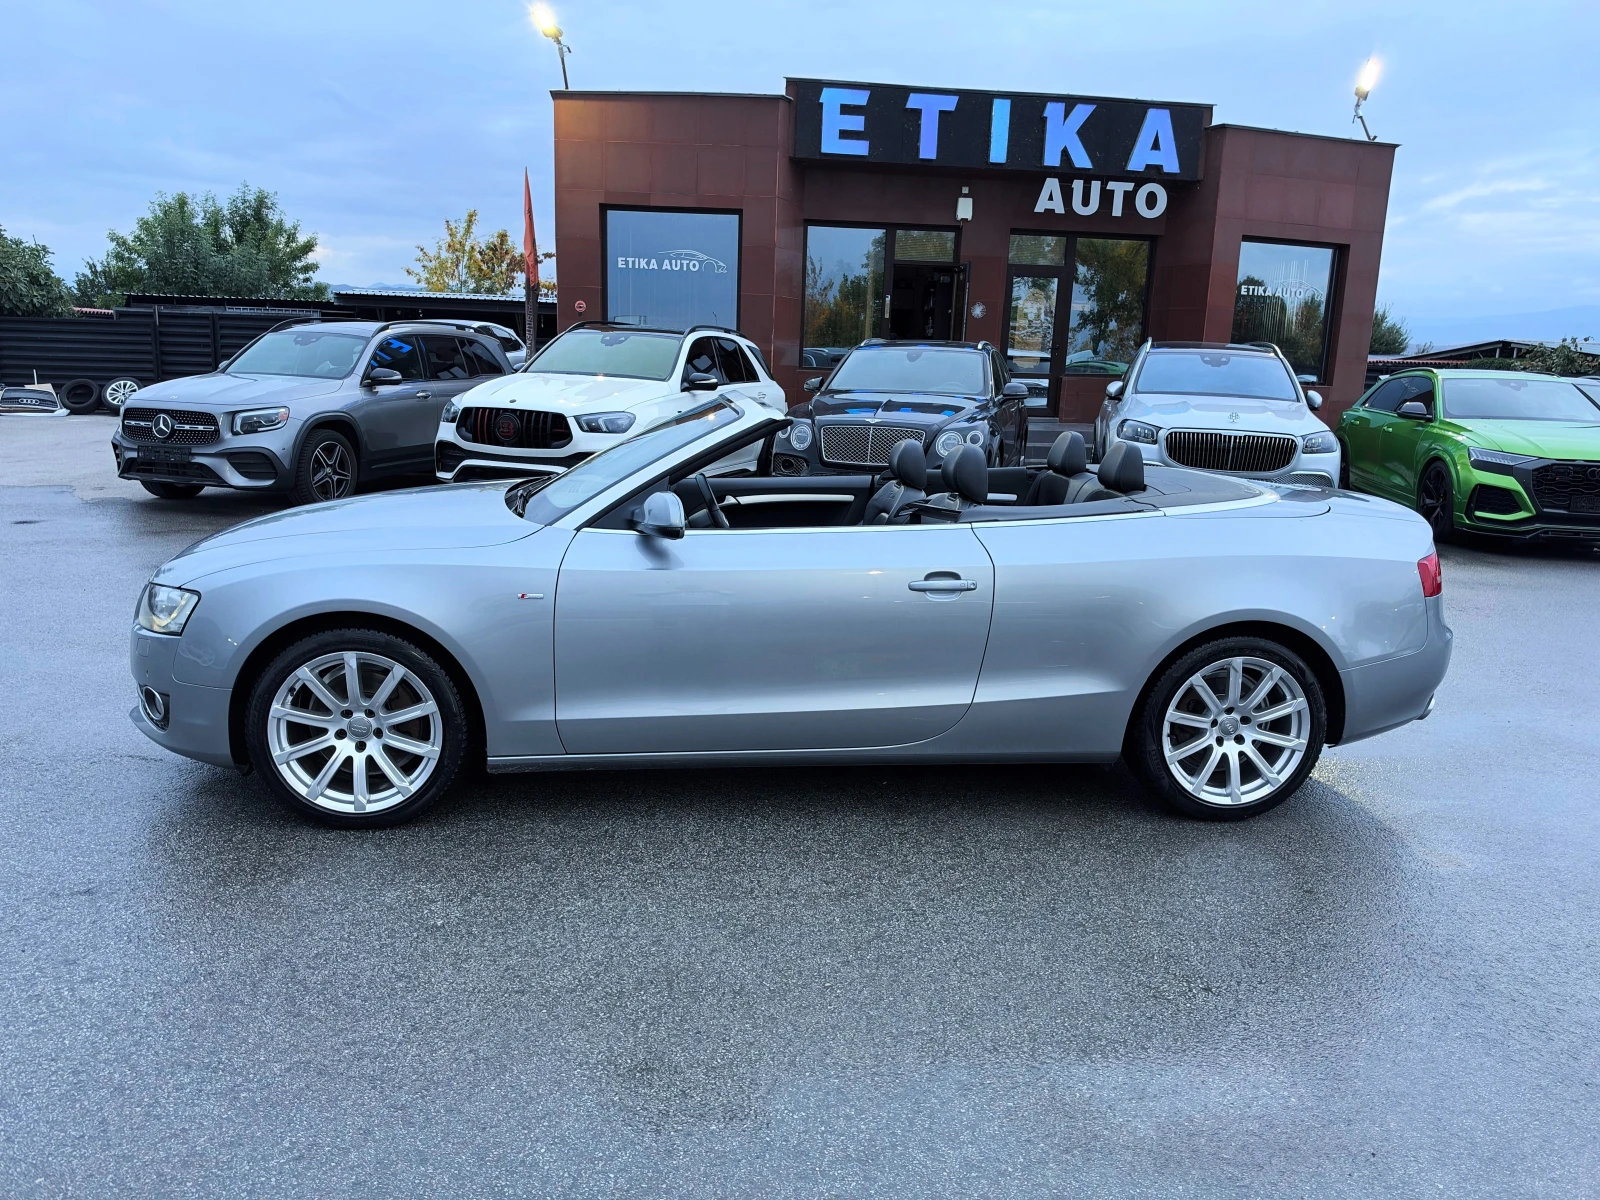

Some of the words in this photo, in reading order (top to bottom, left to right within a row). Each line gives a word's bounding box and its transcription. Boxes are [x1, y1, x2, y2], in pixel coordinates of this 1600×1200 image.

[819, 87, 1181, 173] ETIKA
[1033, 177, 1168, 219] AUTO
[617, 257, 658, 270] ETIKA
[662, 259, 700, 272] AUTO
[1240, 285, 1272, 297] ETIKA
[1275, 287, 1304, 299] AUTO
